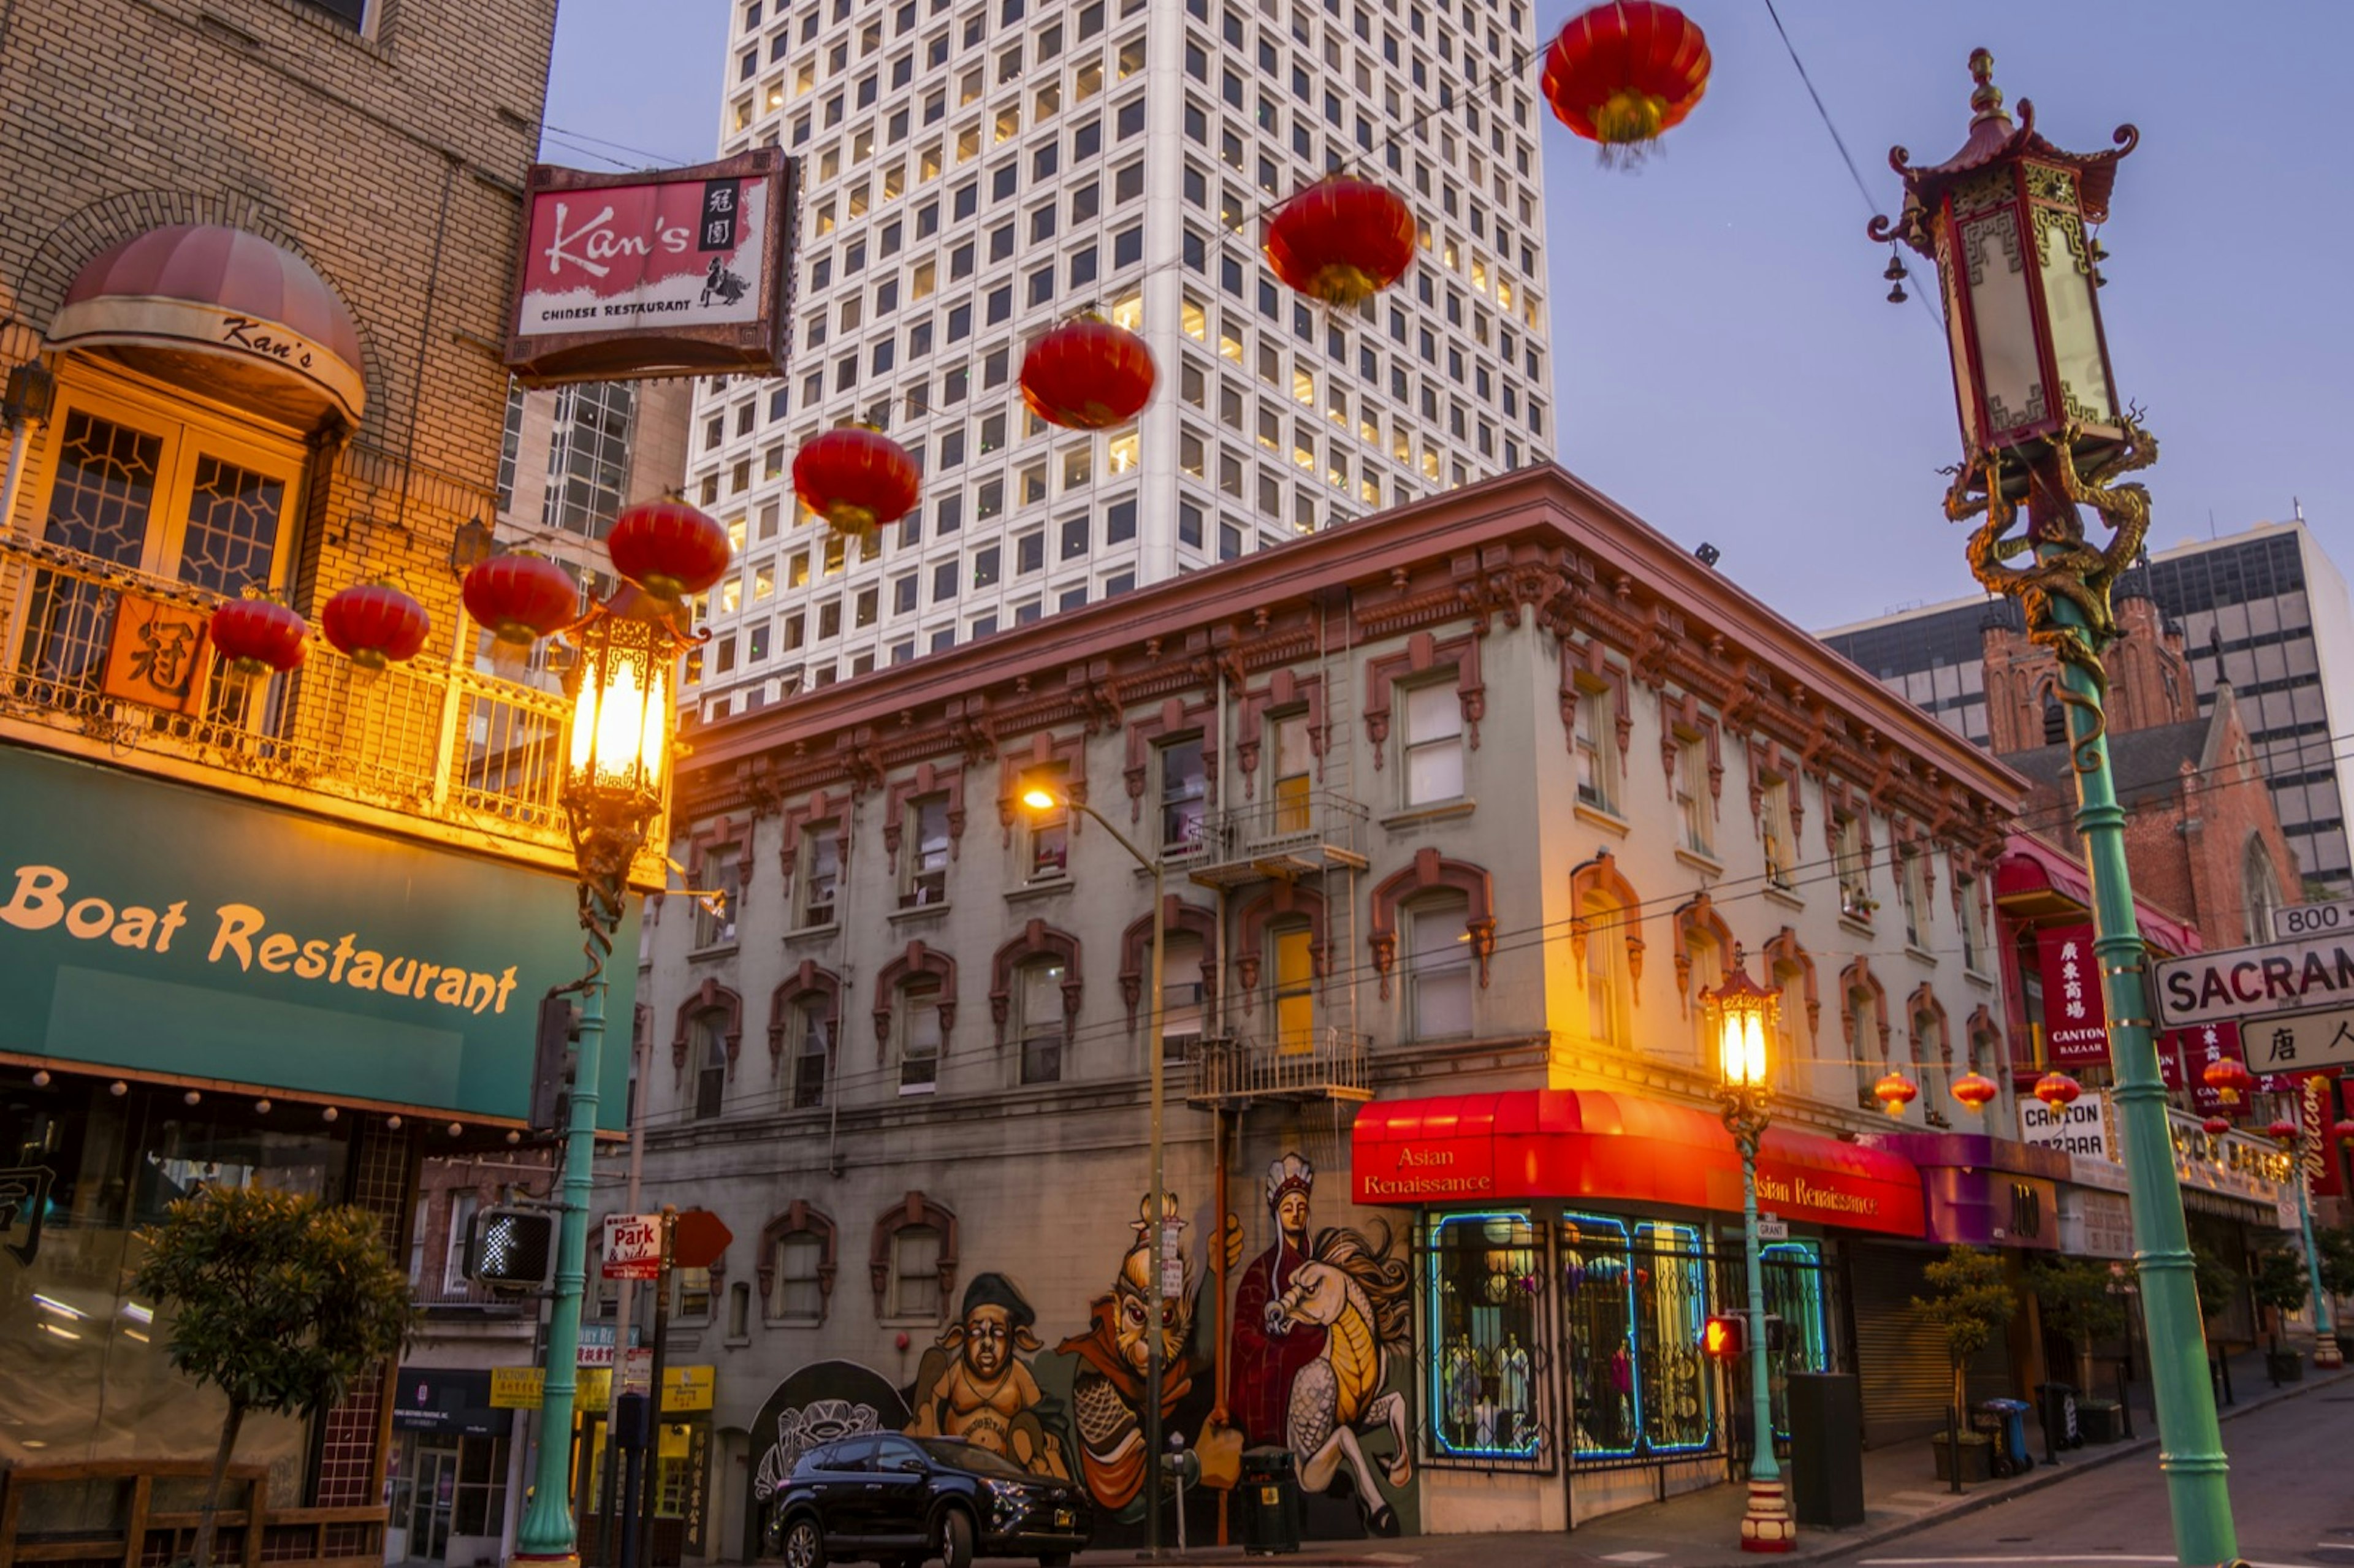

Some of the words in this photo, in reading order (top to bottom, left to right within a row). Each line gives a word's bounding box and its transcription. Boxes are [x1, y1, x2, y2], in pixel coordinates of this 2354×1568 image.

[545, 202, 690, 278] Kan's
[542, 306, 597, 321] CHINESE
[604, 299, 690, 316] RESTAURANT
[223, 317, 312, 368] Kan's
[2288, 905, 2339, 933] 800
[0, 865, 188, 953] Boat
[208, 904, 518, 1014] Restaurant
[2052, 1027, 2106, 1043] CANTON
[2059, 1043, 2103, 1055] BAZAAR
[2025, 1105, 2098, 1127] CANTON
[2028, 1135, 2102, 1154] ZAAR
[1398, 1147, 1454, 1166] Asian
[1364, 1175, 1490, 1194] Renaissance
[1795, 1177, 1879, 1216] Renaissance
[614, 1224, 654, 1246] Park
[1759, 1224, 1783, 1236] GRANT
[609, 1247, 618, 1261] &
[624, 1243, 648, 1260] ride
